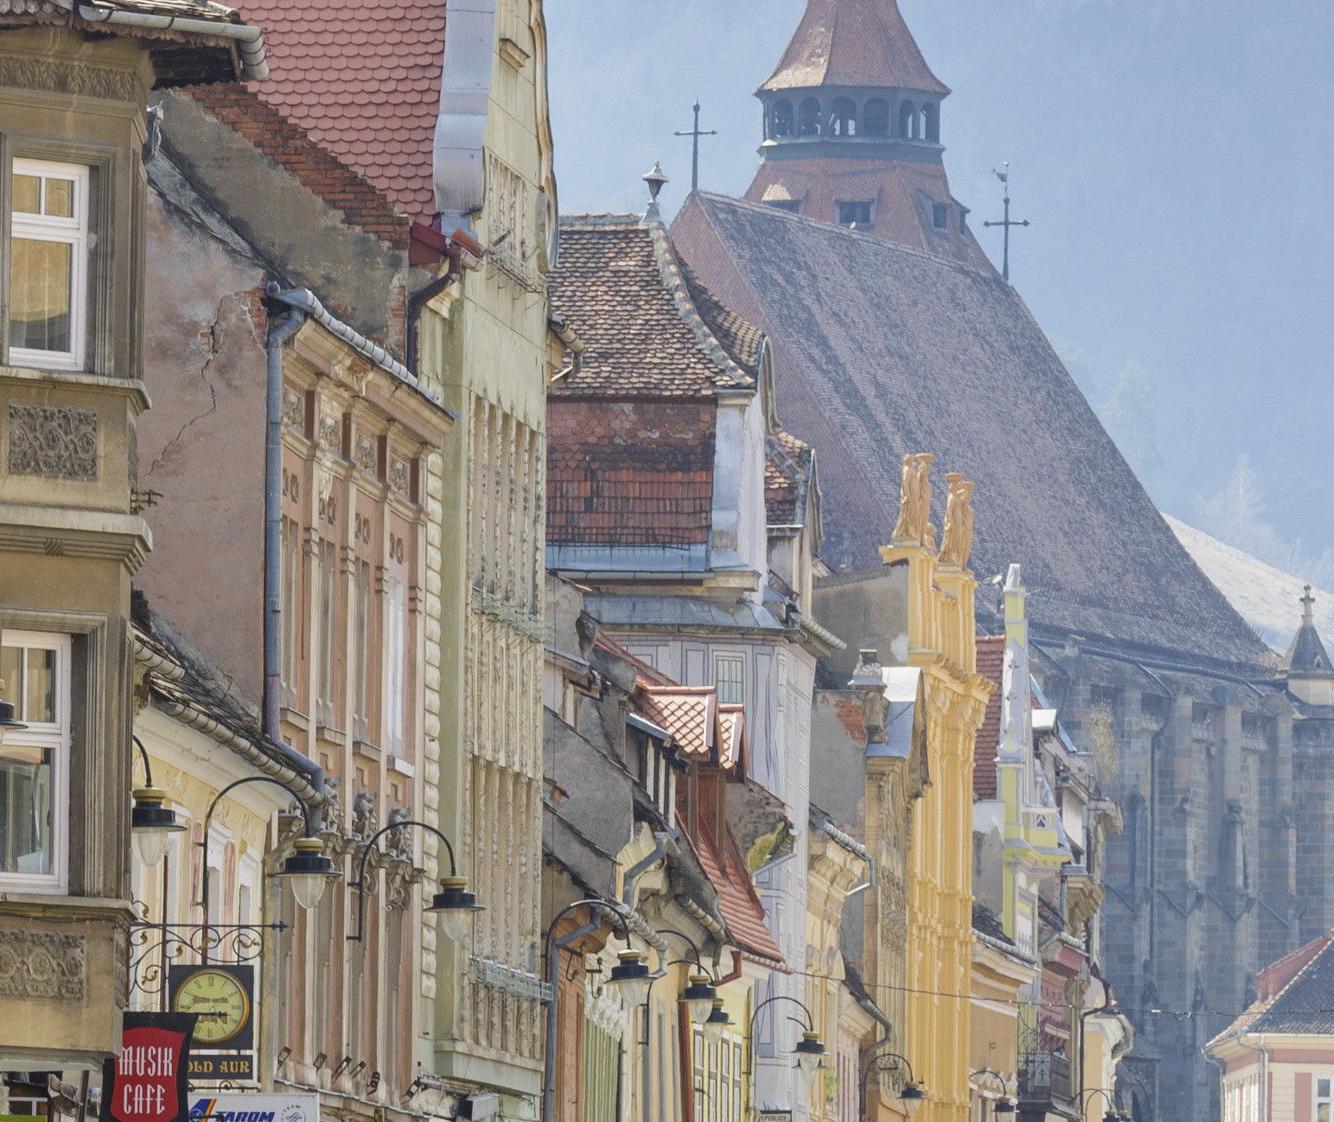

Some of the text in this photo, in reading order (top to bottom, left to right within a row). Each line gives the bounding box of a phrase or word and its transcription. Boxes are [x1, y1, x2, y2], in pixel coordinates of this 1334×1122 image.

[118, 1044, 174, 1077] MUSIK
[219, 1060, 251, 1074] AUR
[123, 1083, 166, 1116] CAFE
